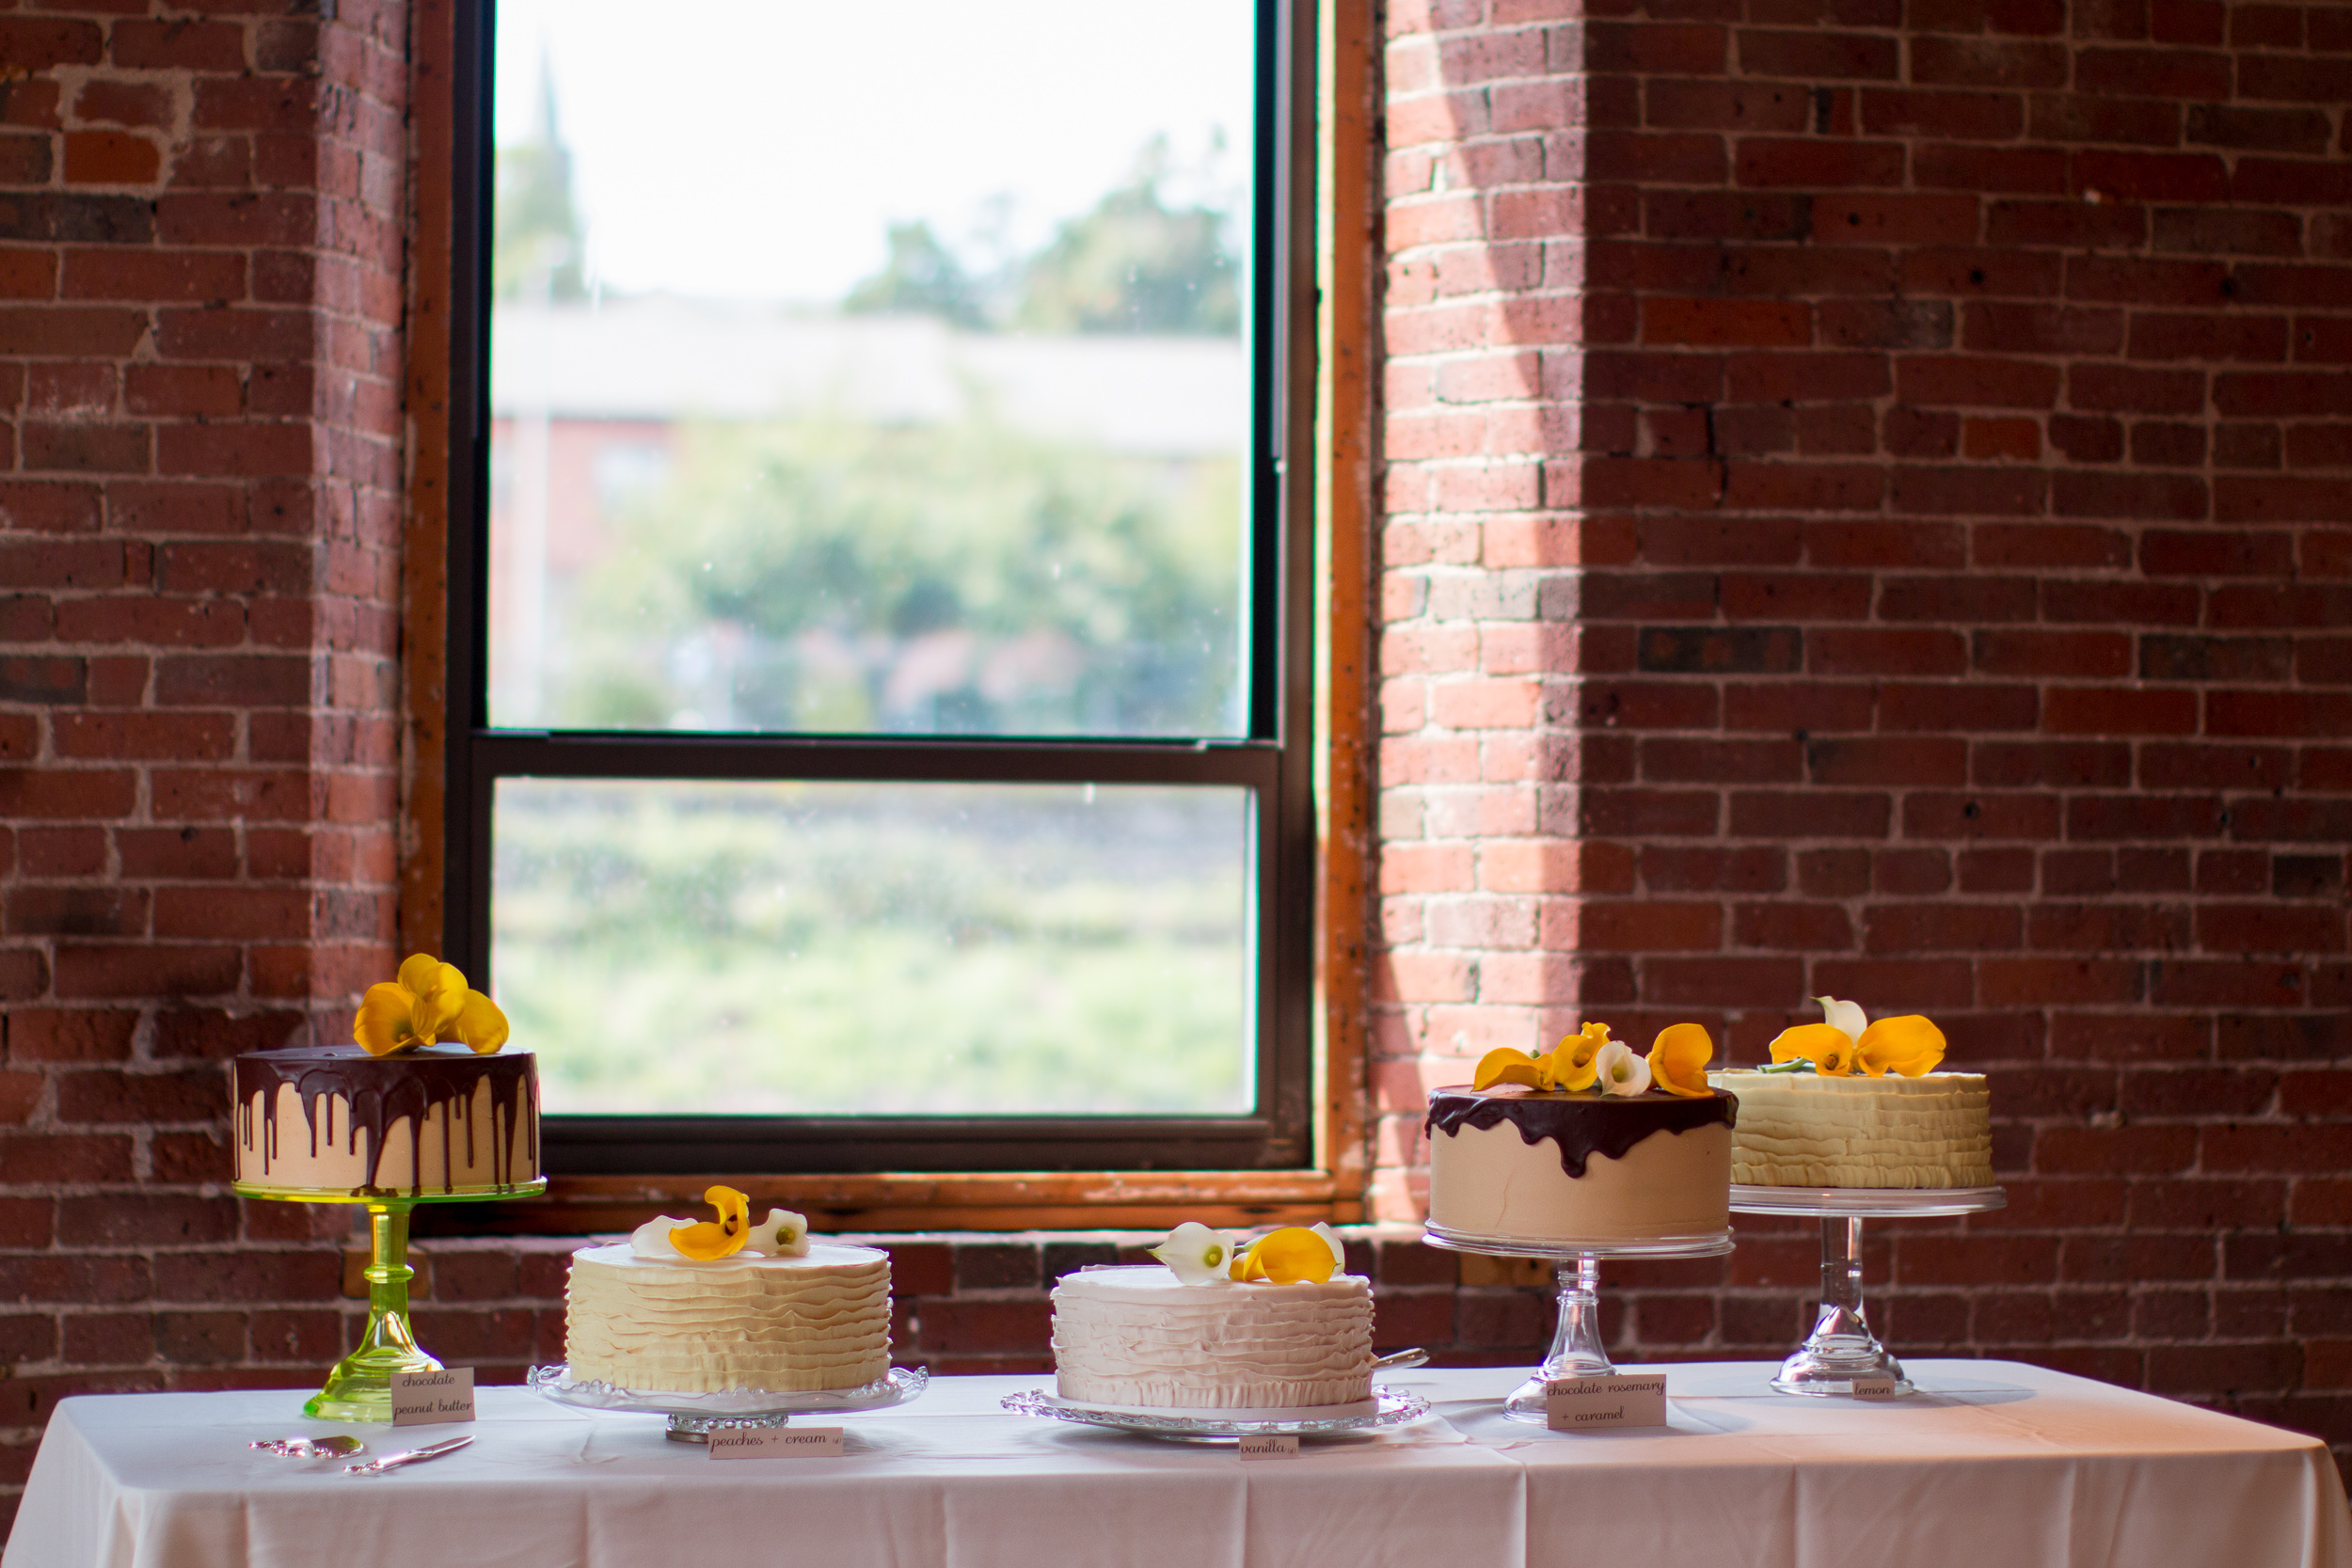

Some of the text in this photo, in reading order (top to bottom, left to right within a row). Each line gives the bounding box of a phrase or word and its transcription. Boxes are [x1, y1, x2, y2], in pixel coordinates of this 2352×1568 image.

[403, 1373, 455, 1387] chocolate
[1547, 1381, 1665, 1397] chocolate rosemary
[1854, 1383, 1891, 1396] lemon
[393, 1399, 472, 1421] peanut butter
[1562, 1405, 1625, 1421] + caramel
[710, 1432, 765, 1453] peaches
[771, 1434, 779, 1443] +
[785, 1434, 827, 1445] cream
[1241, 1438, 1286, 1453] vanilla
